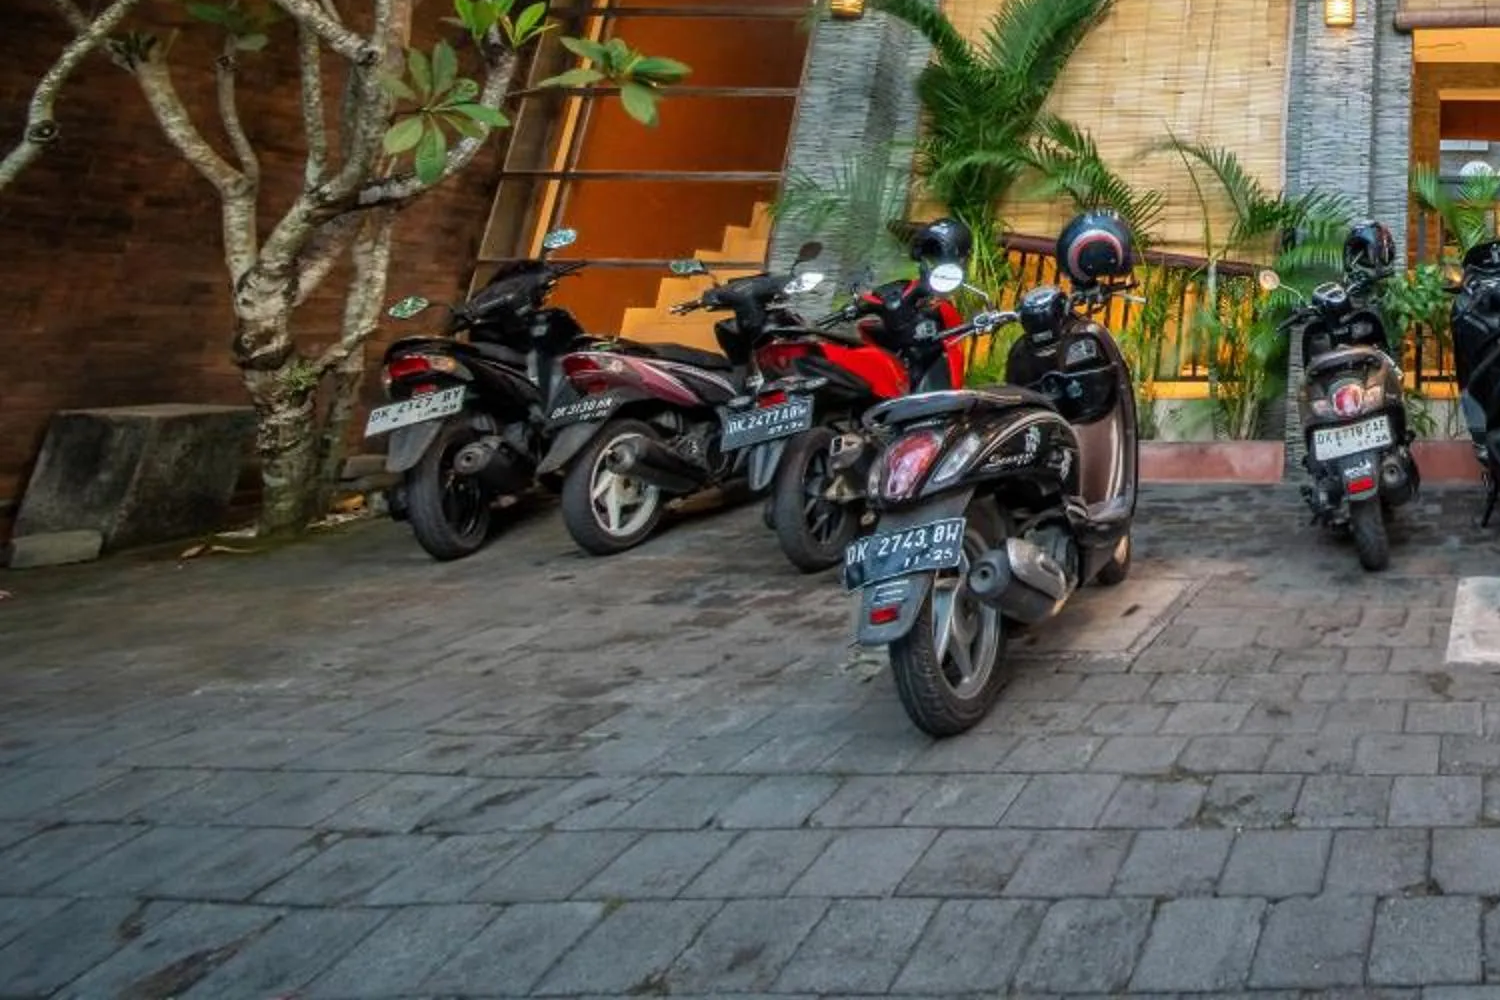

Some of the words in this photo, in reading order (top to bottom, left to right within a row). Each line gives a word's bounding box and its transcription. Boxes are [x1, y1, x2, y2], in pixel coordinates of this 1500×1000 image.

[370, 410, 388, 423] DK
[728, 419, 746, 435] DK
[846, 542, 868, 565] DK
[877, 528, 926, 557] 2743
